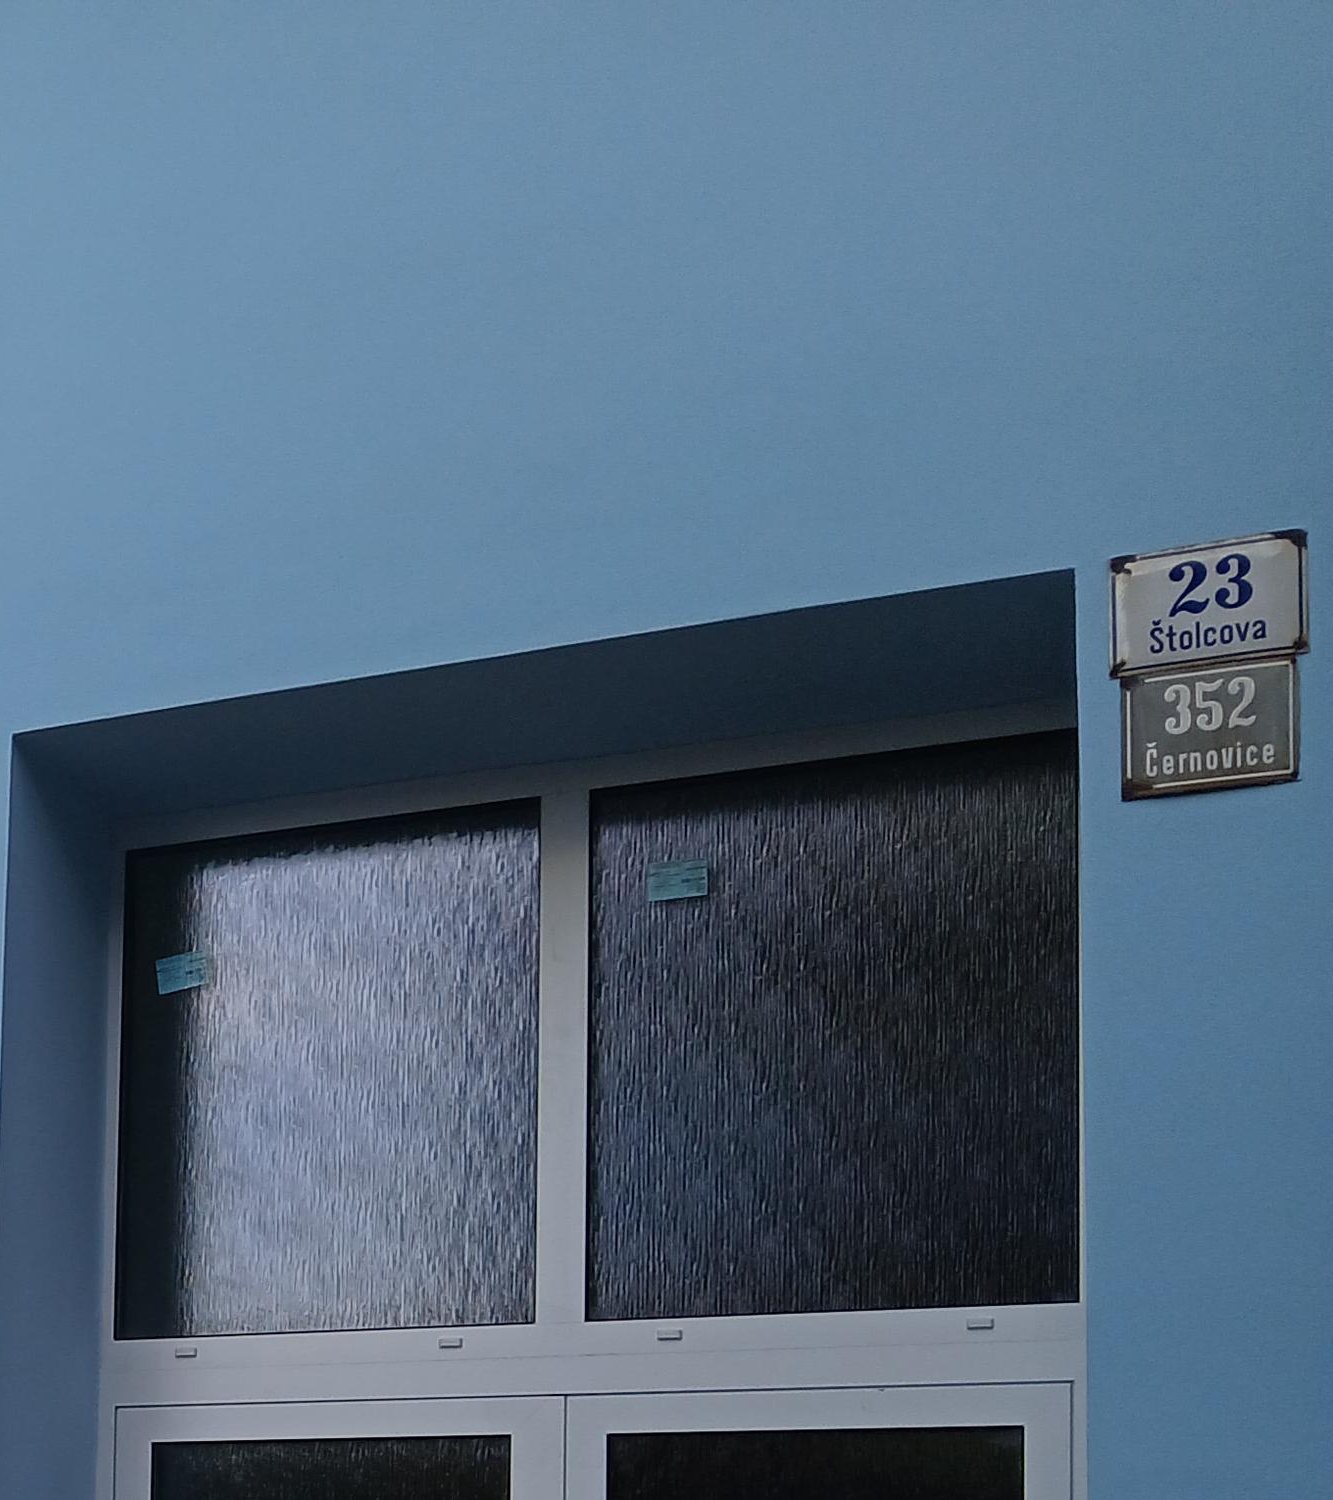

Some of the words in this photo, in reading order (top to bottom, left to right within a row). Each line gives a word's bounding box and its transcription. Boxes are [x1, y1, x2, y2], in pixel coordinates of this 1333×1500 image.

[1168, 553, 1253, 618] 23
[1149, 618, 1268, 655] Štolcova
[1164, 676, 1257, 736] 352
[1145, 741, 1276, 779] Černovice
